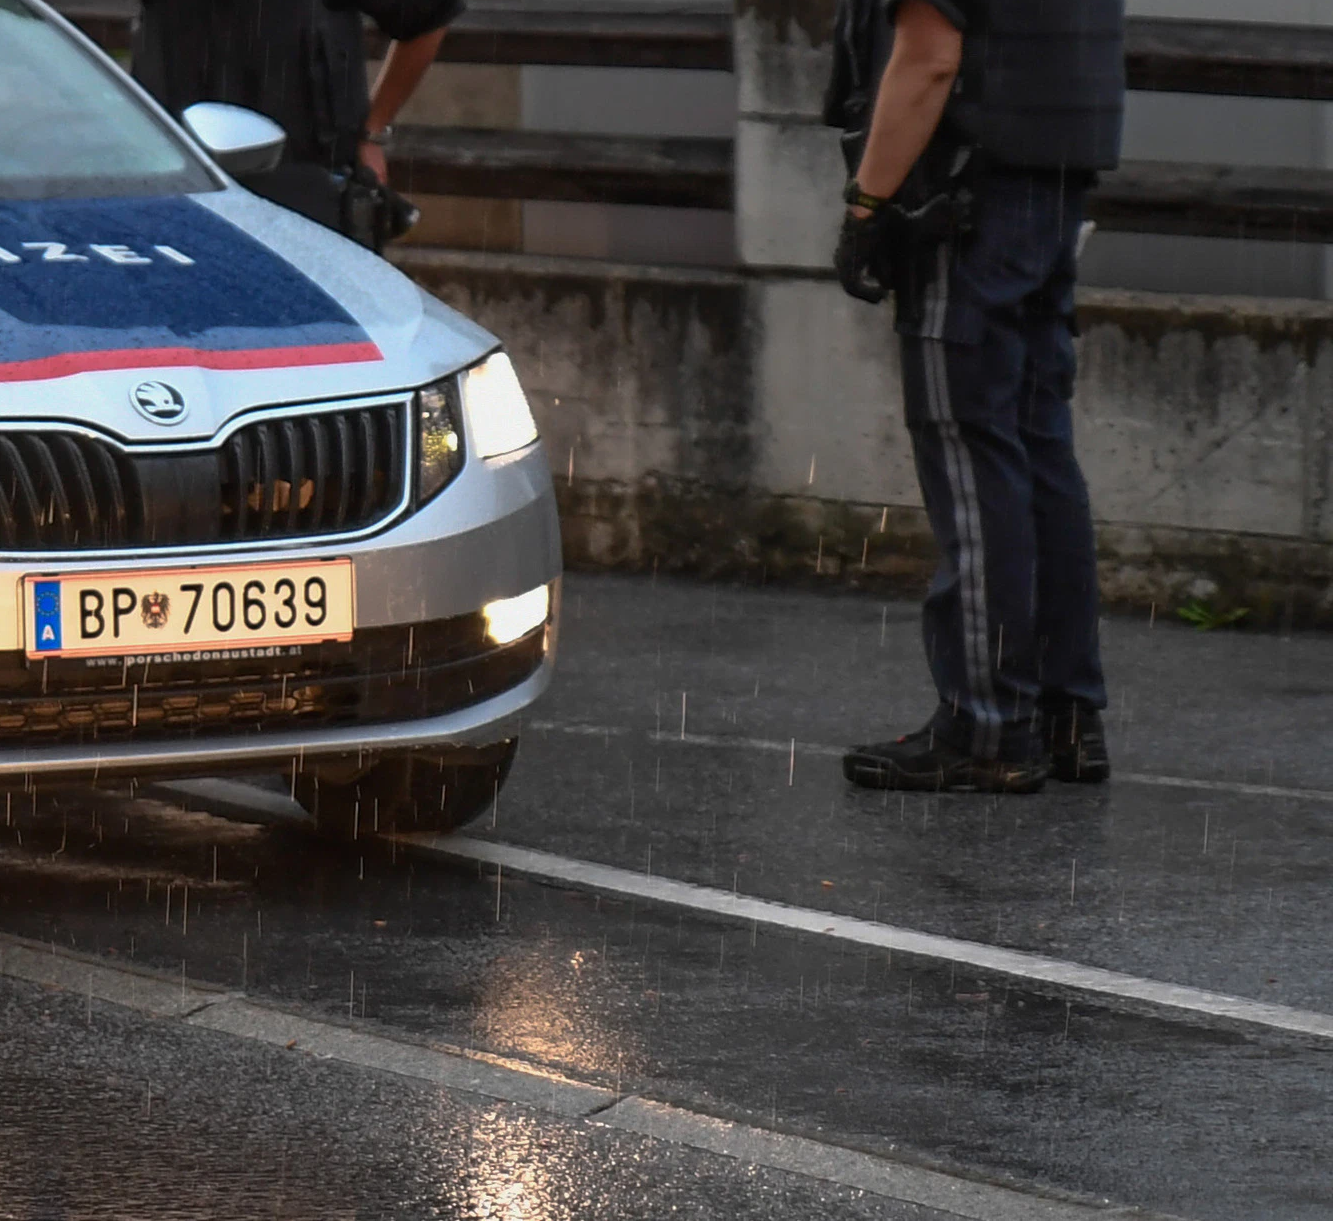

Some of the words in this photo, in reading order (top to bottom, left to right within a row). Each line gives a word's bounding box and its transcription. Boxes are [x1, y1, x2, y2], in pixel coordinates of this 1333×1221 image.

[42, 625, 55, 641] A
[80, 587, 137, 639] BP
[180, 576, 327, 634] 70639
